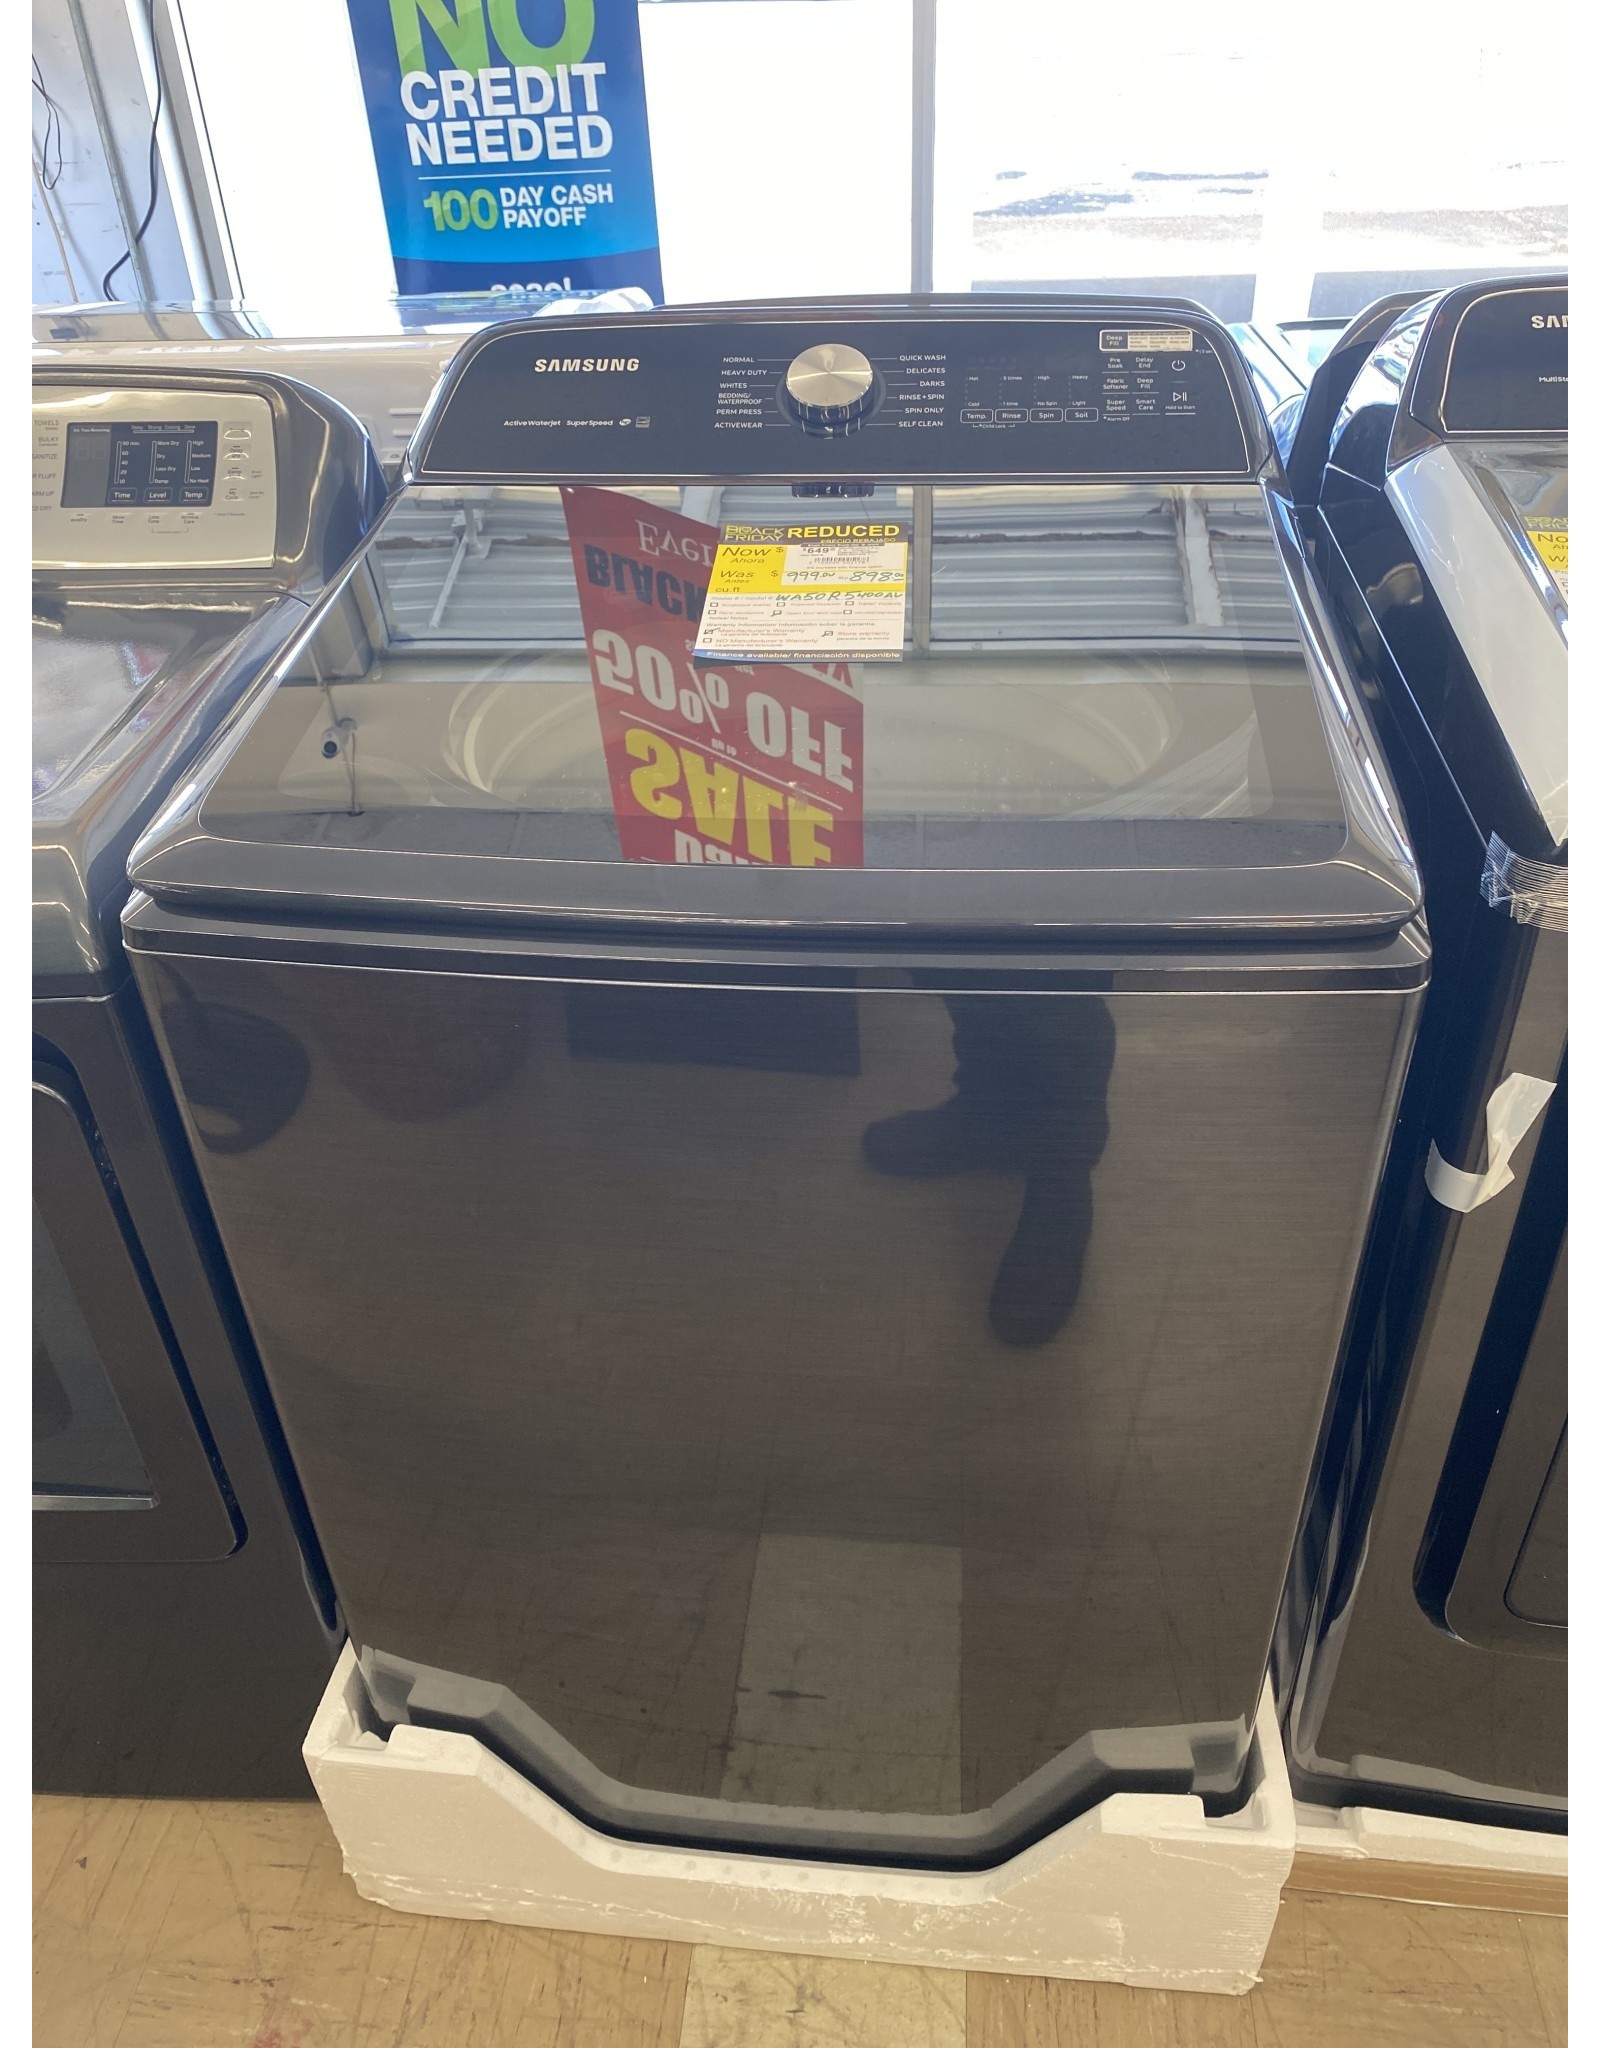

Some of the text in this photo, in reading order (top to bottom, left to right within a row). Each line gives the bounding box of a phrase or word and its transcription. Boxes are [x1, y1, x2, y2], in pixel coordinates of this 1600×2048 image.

[389, 0, 595, 80] NO
[401, 62, 606, 120] CREDIT
[406, 115, 613, 166] NEEDED
[423, 183, 614, 231] 100 DAY CASH
[503, 206, 587, 229] PAYOFF
[534, 358, 640, 372] SAMSUNG
[724, 533, 784, 542] FRIDAY
[726, 524, 900, 539] BLACK REDUCED
[722, 546, 771, 557] Now
[776, 546, 784, 554] $
[720, 570, 755, 578] Was
